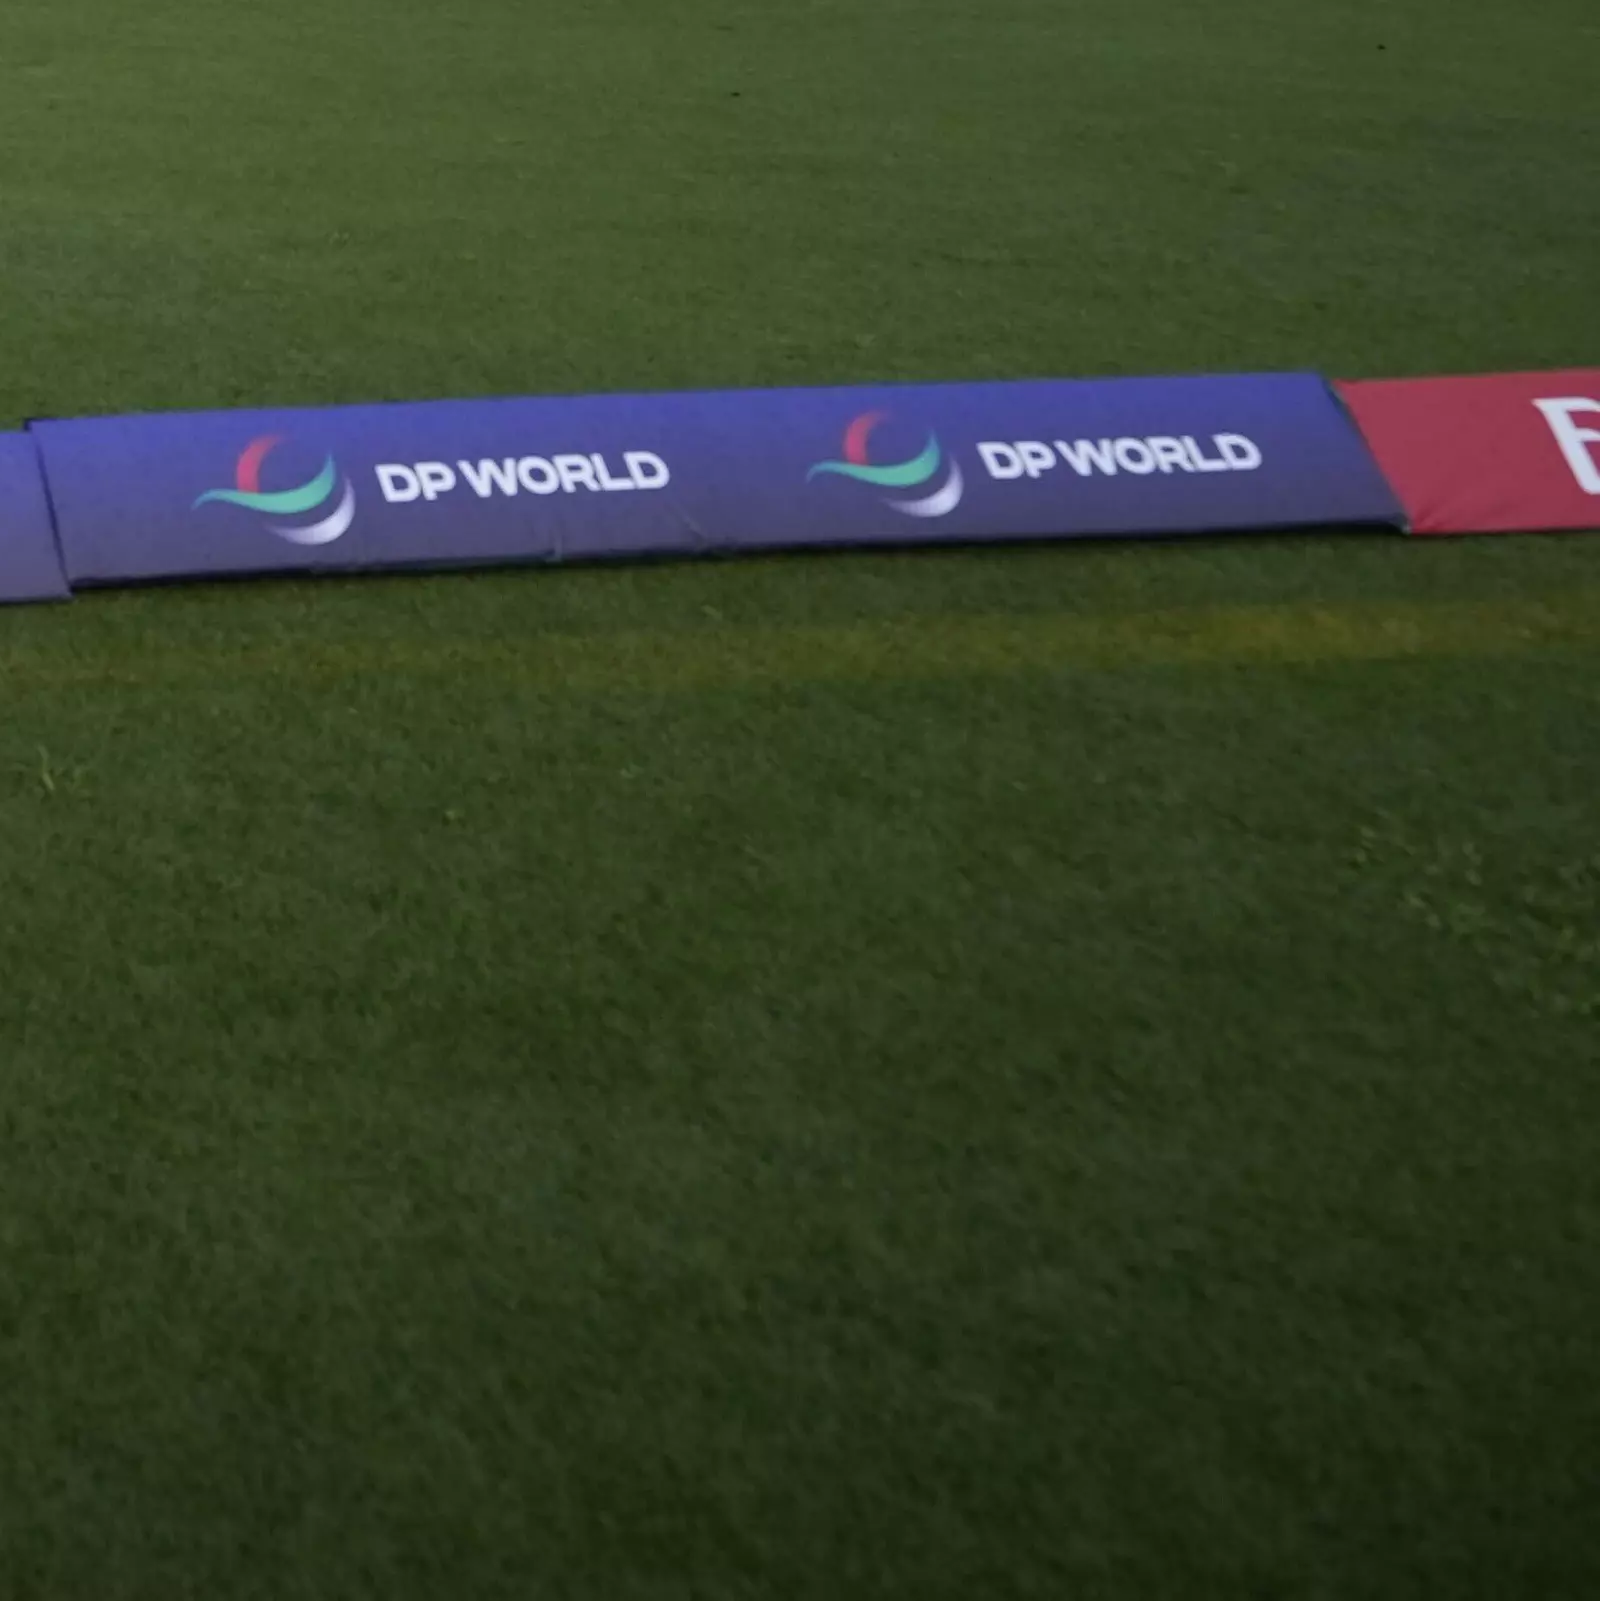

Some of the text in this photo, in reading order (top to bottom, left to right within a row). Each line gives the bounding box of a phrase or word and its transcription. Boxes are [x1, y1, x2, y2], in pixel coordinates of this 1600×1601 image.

[375, 451, 670, 502] DP WORLD
[977, 434, 1261, 479] DP WORLD
